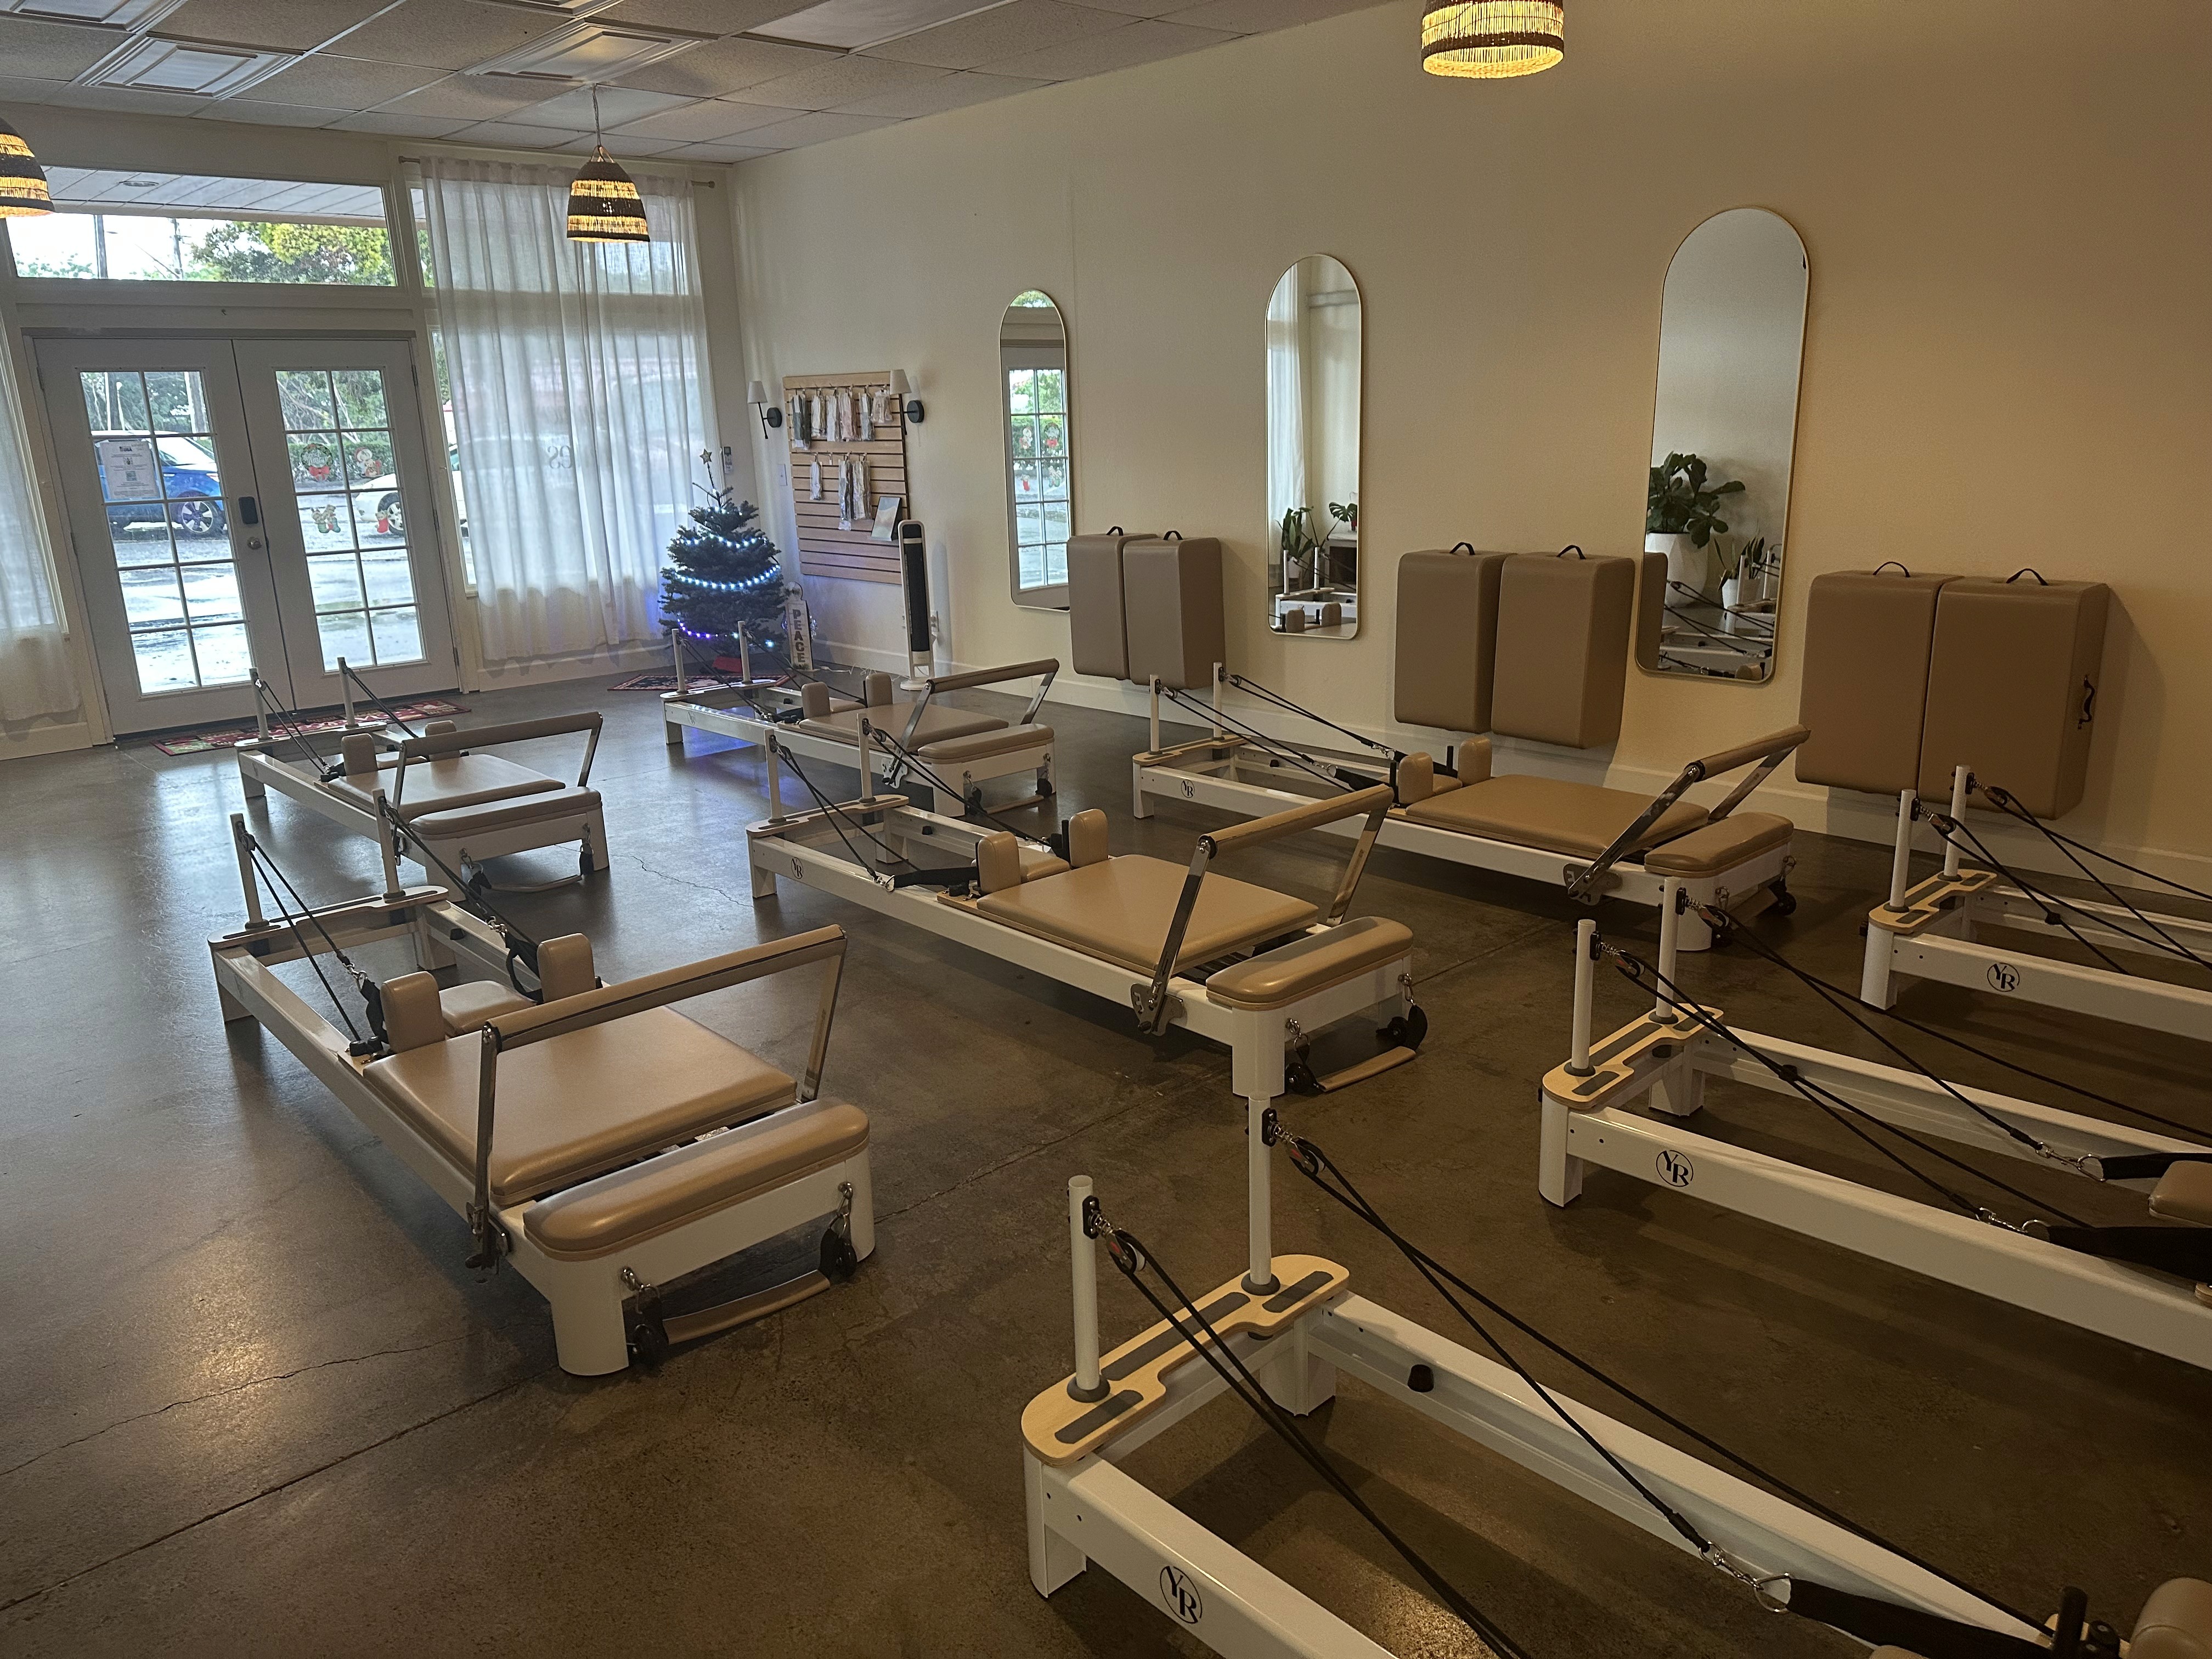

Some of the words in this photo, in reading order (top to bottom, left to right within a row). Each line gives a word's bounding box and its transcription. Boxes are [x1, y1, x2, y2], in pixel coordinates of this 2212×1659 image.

[792, 609, 805, 662] PEACE
[1182, 780, 1193, 797] YR
[792, 858, 803, 877] YR
[1993, 963, 2016, 990] YR
[1662, 1150, 1689, 1185] YR
[1165, 1566, 1198, 1622] YR
